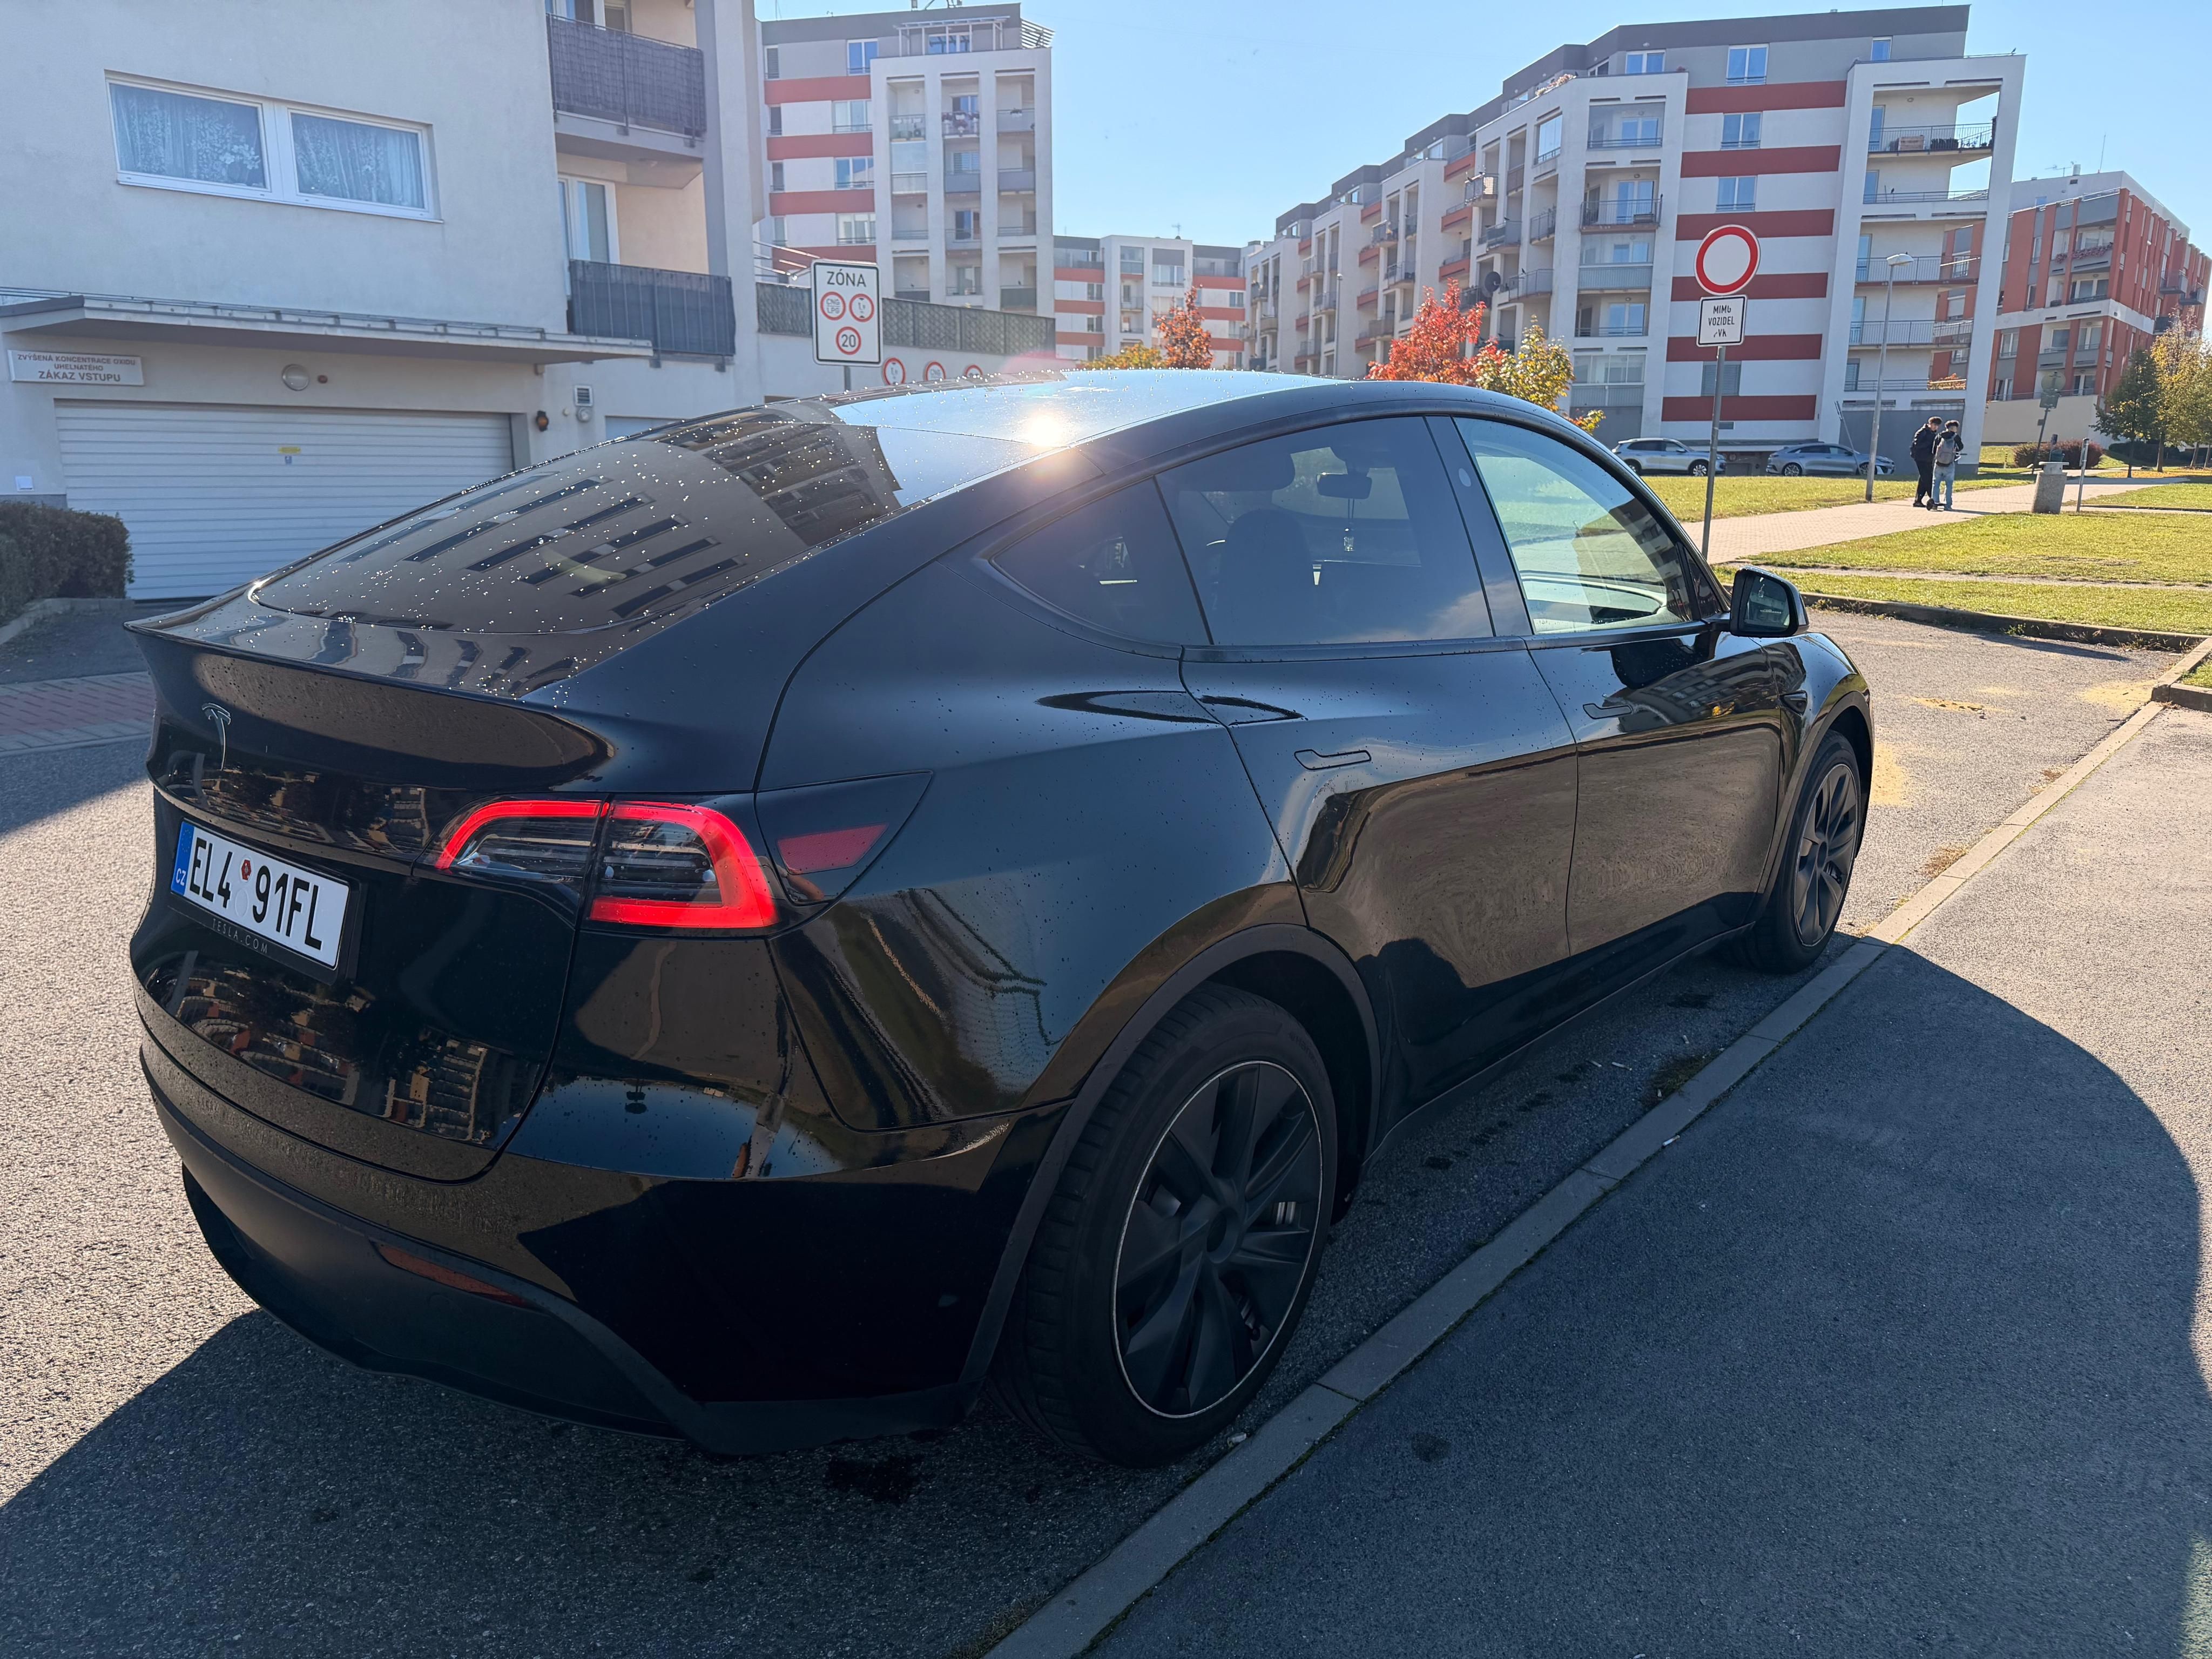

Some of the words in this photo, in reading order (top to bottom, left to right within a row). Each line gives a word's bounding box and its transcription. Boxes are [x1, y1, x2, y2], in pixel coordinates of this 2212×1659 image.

[827, 269, 866, 287] ZÓNA
[1708, 316, 1735, 326] VOZIDEL
[841, 334, 856, 347] 20
[17, 353, 53, 361] ZVÝŠENÁ
[55, 355, 112, 365] KONCENTRACE
[38, 369, 76, 380] ZÁKAZ
[78, 373, 121, 382] VSTUPU
[176, 868, 187, 886] CZ
[190, 837, 233, 909] EL4
[252, 865, 322, 951] 91FL
[212, 918, 268, 954] TESLA.COM
